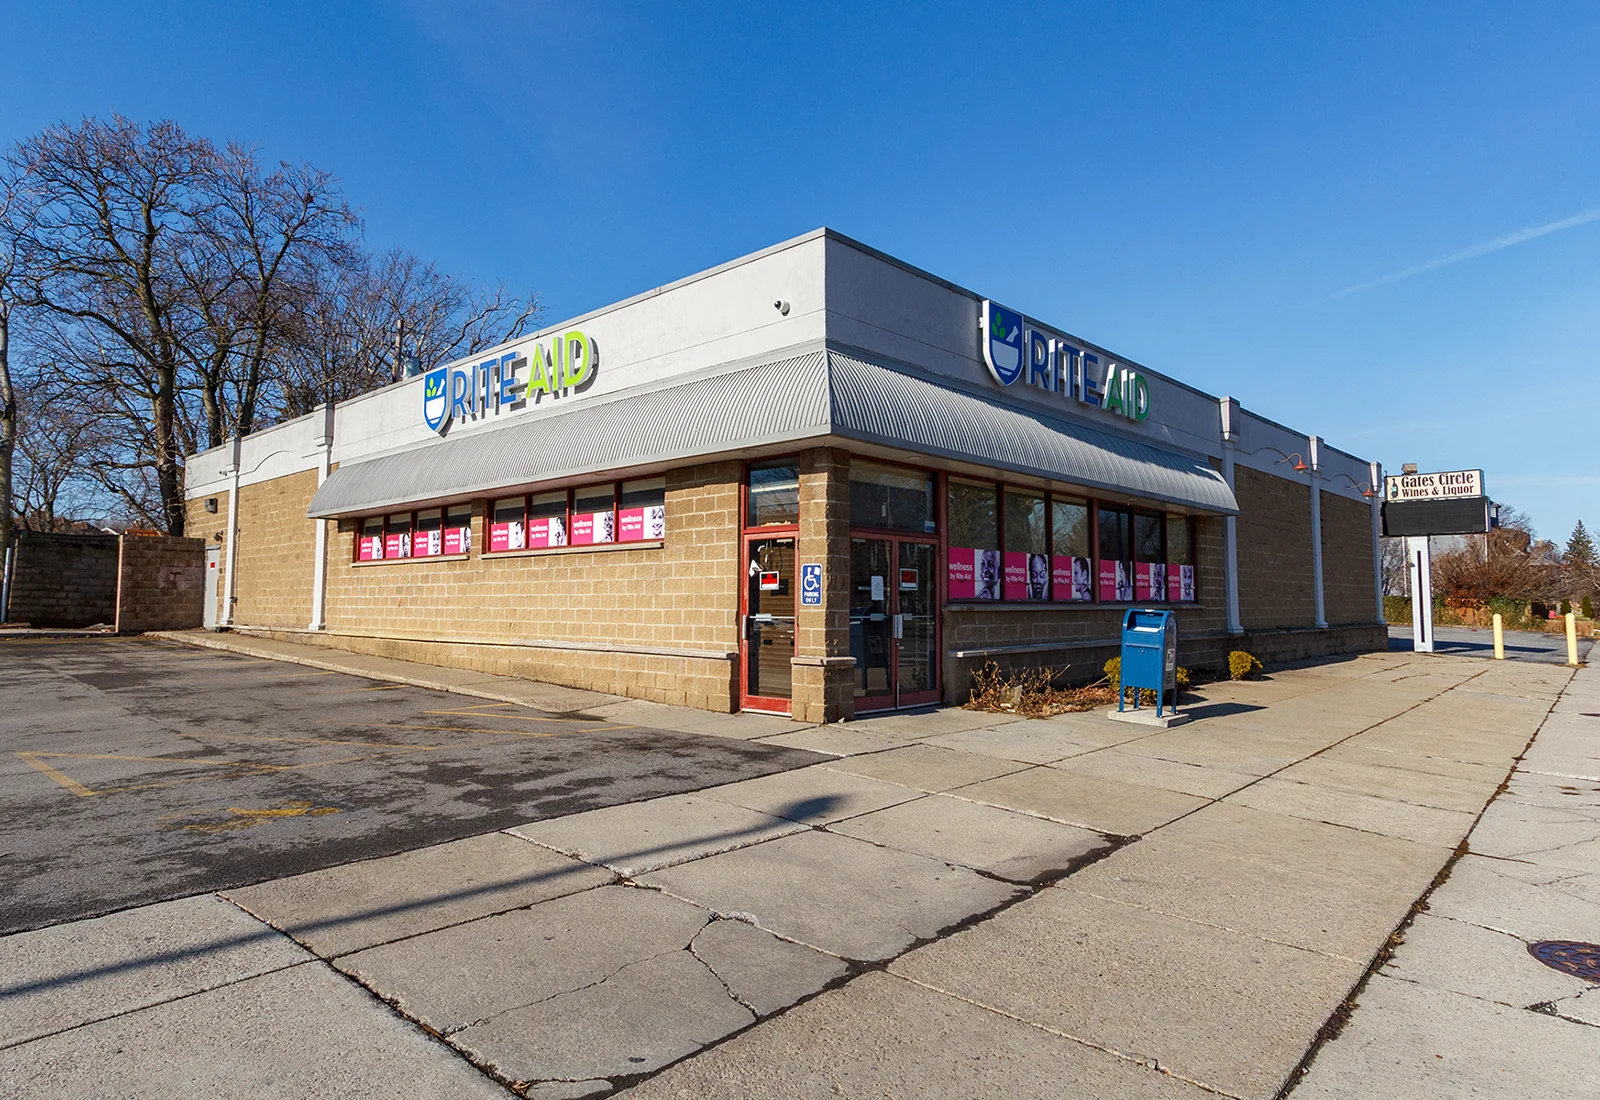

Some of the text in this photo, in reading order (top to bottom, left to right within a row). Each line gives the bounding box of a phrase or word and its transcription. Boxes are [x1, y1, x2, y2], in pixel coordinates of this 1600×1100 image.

[451, 330, 592, 418] RITE AID
[1025, 329, 1150, 421] RITE AID
[1401, 472, 1474, 488] Gates Circle
[1402, 485, 1474, 498] Wines & Liquor
[573, 520, 592, 528] wellness
[621, 515, 642, 523] wellness
[949, 562, 973, 571] wellness
[1005, 566, 1025, 574] wellness
